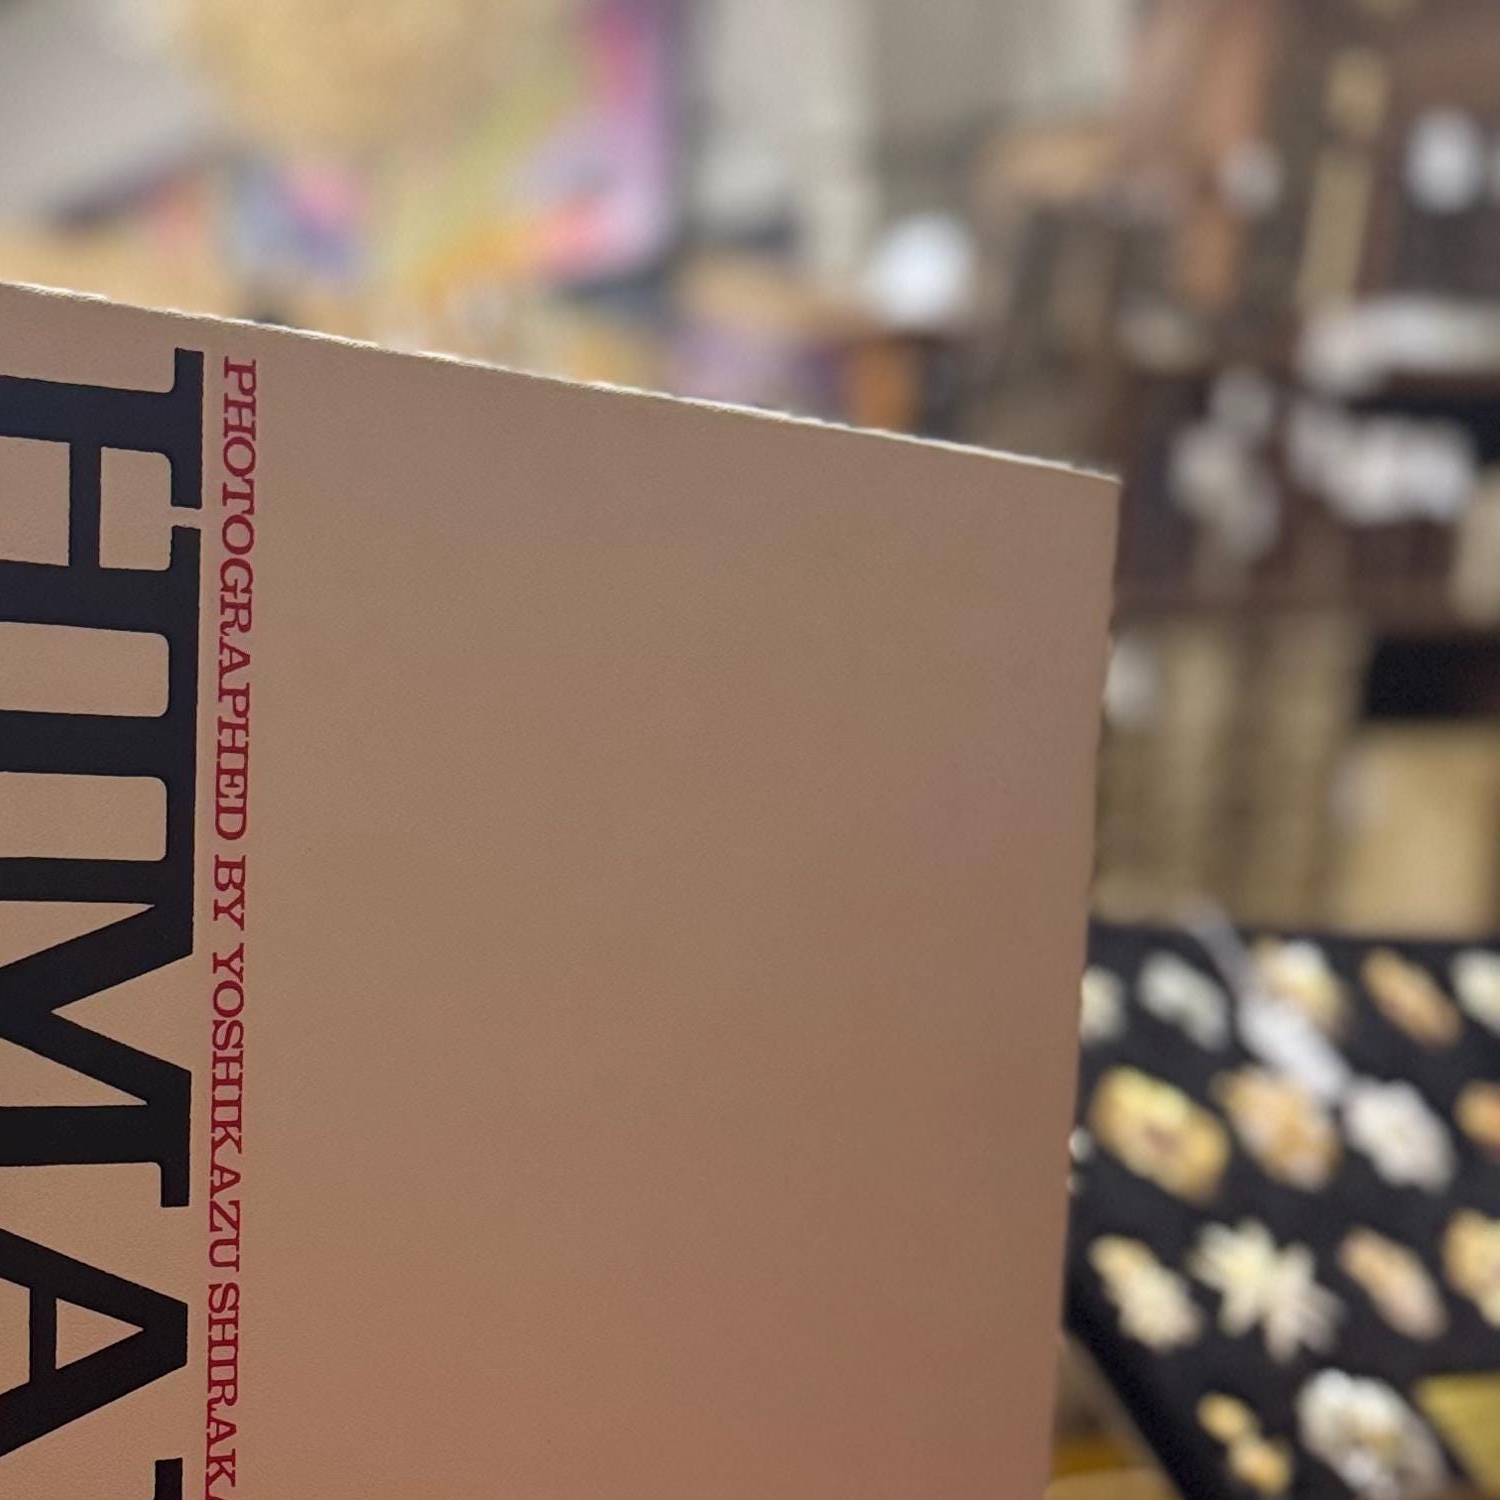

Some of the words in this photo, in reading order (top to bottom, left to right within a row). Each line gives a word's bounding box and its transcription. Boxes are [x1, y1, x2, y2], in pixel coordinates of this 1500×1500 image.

[214, 356, 257, 842] PHOTOGRAPHED
[212, 854, 247, 932] BY
[207, 944, 245, 1273] YOSHIKAZU
